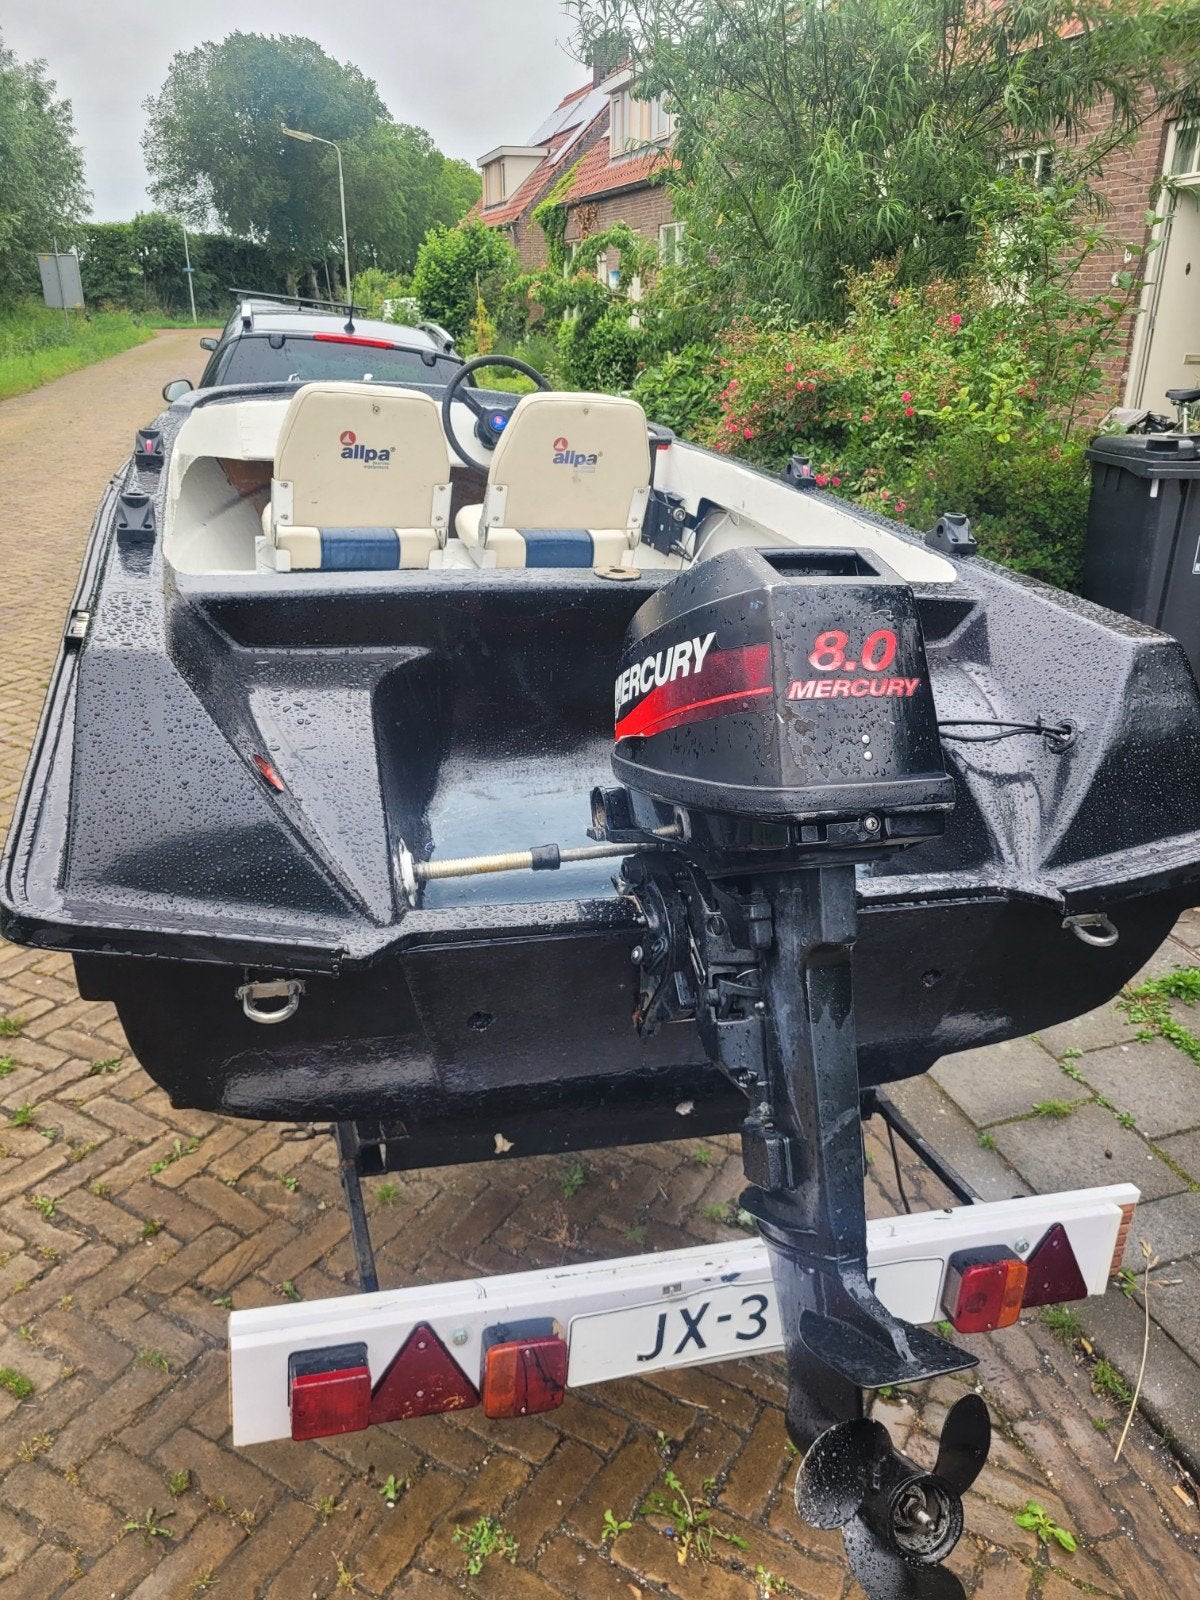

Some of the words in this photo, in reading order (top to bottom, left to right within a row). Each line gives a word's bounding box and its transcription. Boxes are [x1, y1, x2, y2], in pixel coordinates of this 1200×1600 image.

[341, 444, 390, 463] allpa
[553, 450, 598, 468] allpa
[808, 629, 897, 672] 8.0
[787, 677, 919, 701] MERCURY
